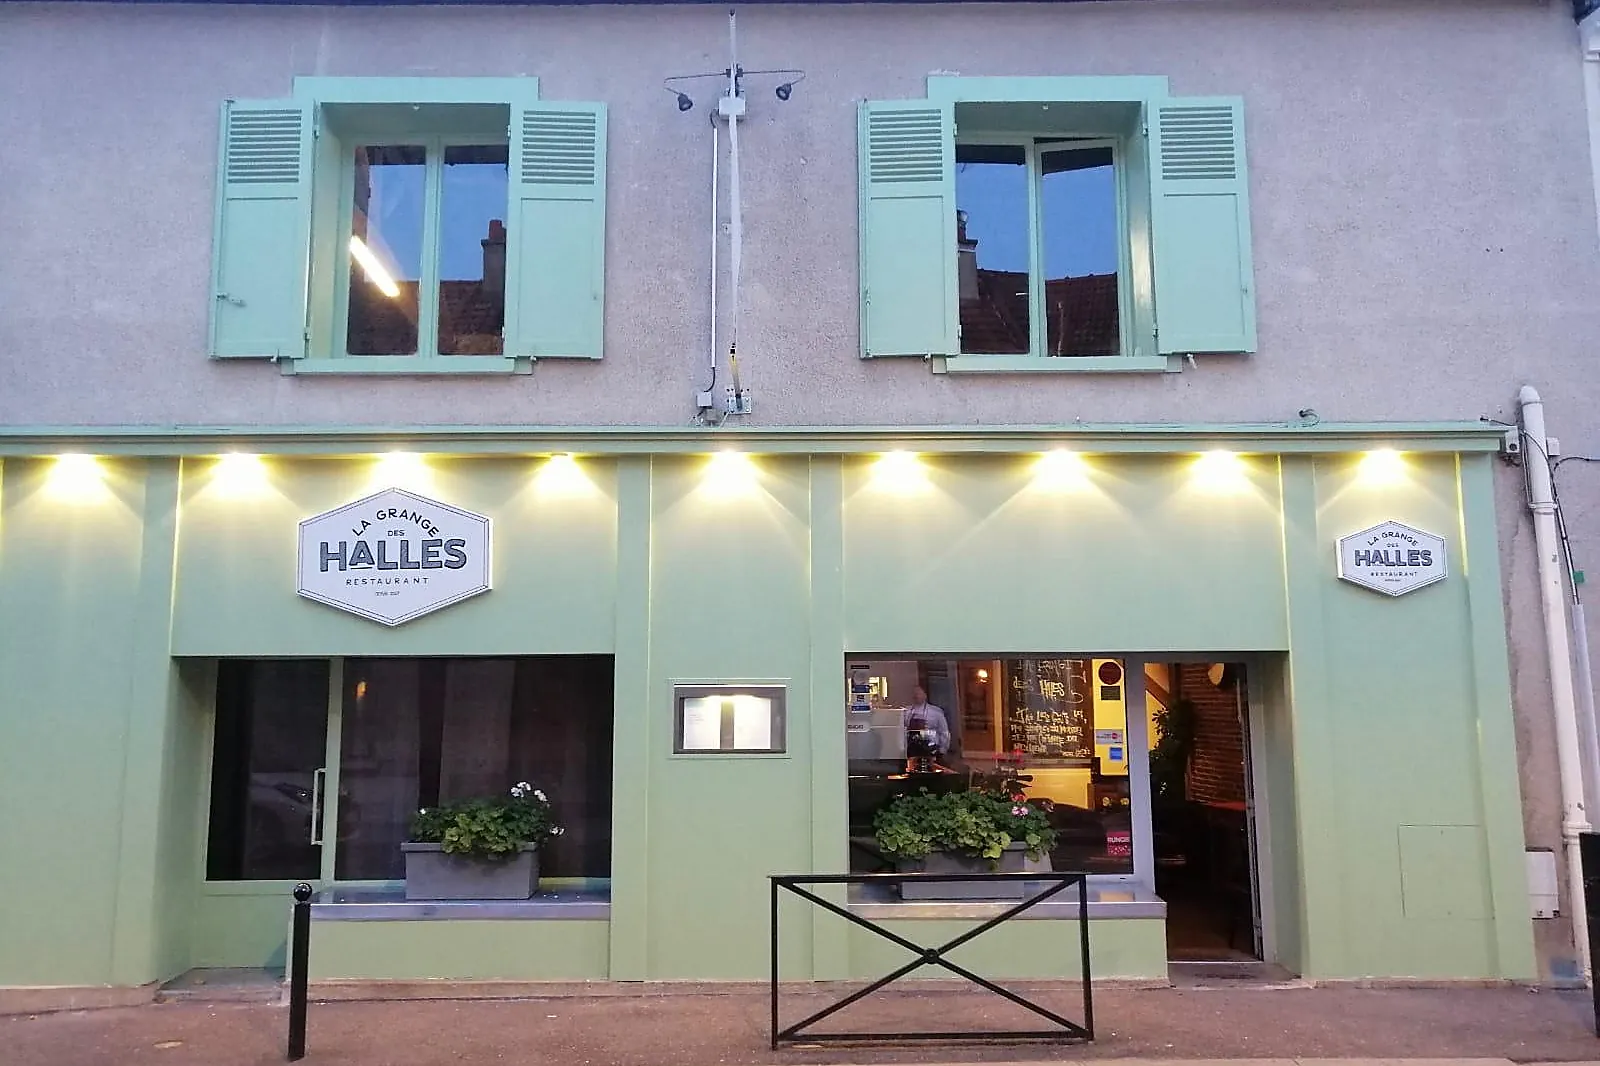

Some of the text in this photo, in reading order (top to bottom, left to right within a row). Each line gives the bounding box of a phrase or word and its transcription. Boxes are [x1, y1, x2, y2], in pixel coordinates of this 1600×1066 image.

[352, 508, 440, 538] LA GRANGE
[1367, 531, 1419, 547] LA GRANGE
[320, 538, 468, 572] HALLES
[1354, 549, 1433, 567] HALLES
[346, 577, 430, 586] RESTAURANT
